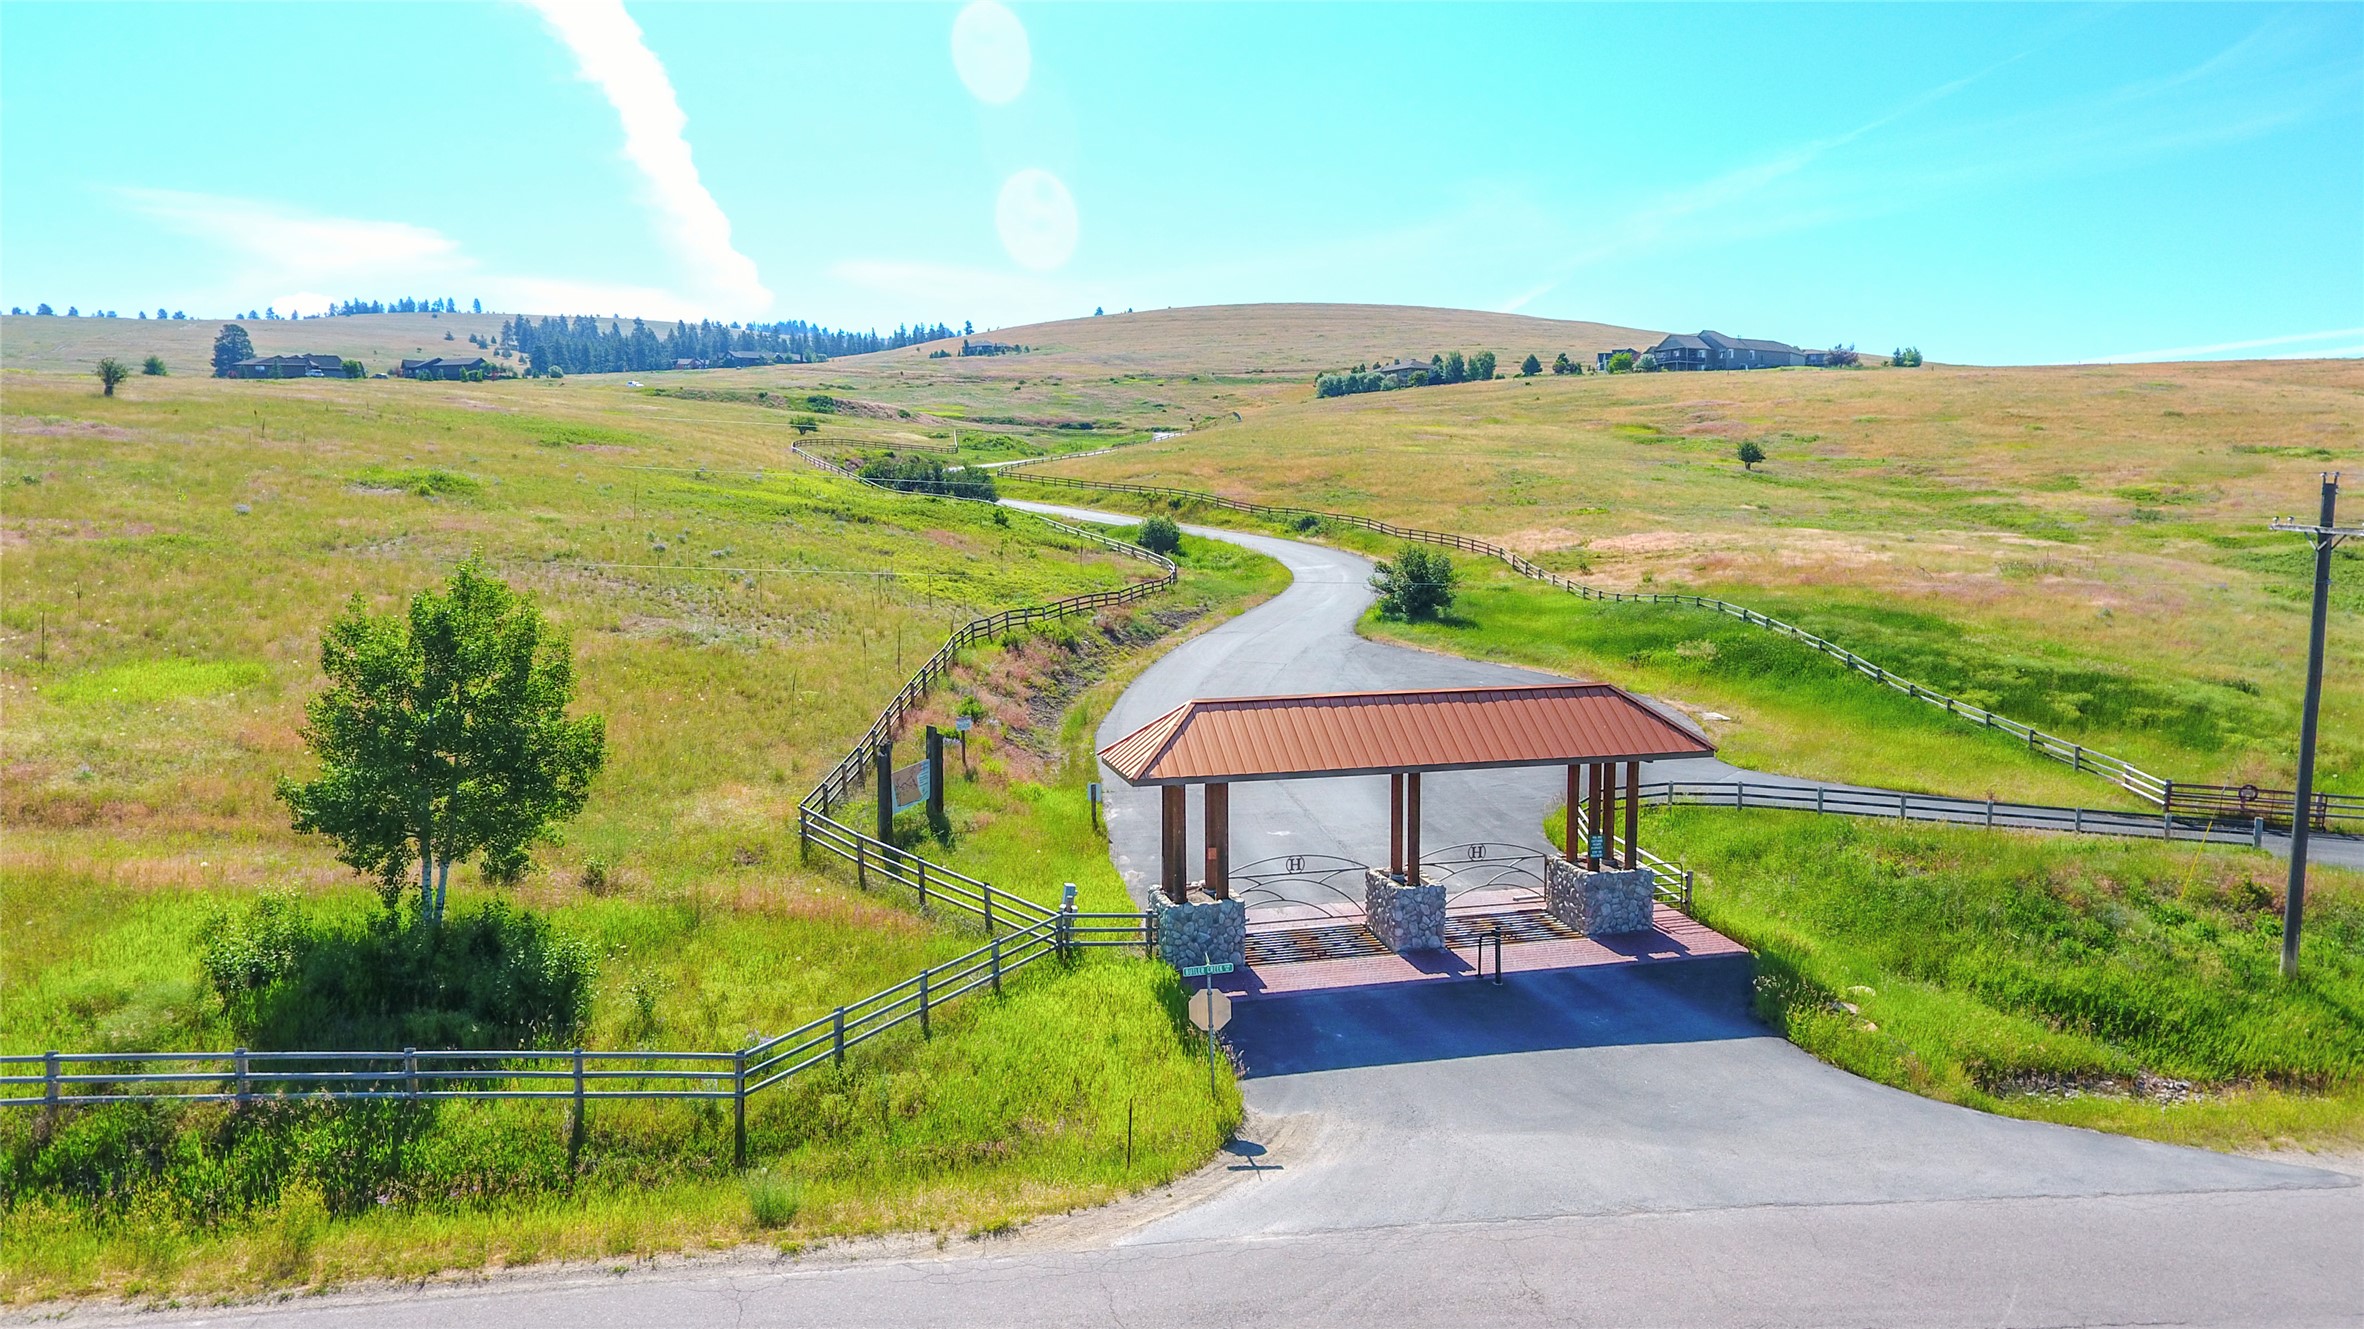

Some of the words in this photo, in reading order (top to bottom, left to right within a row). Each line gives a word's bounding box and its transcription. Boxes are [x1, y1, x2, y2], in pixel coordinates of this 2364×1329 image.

[1471, 846, 1483, 859] H
[1289, 858, 1302, 871] H
[1206, 965, 1223, 975] CREEK
